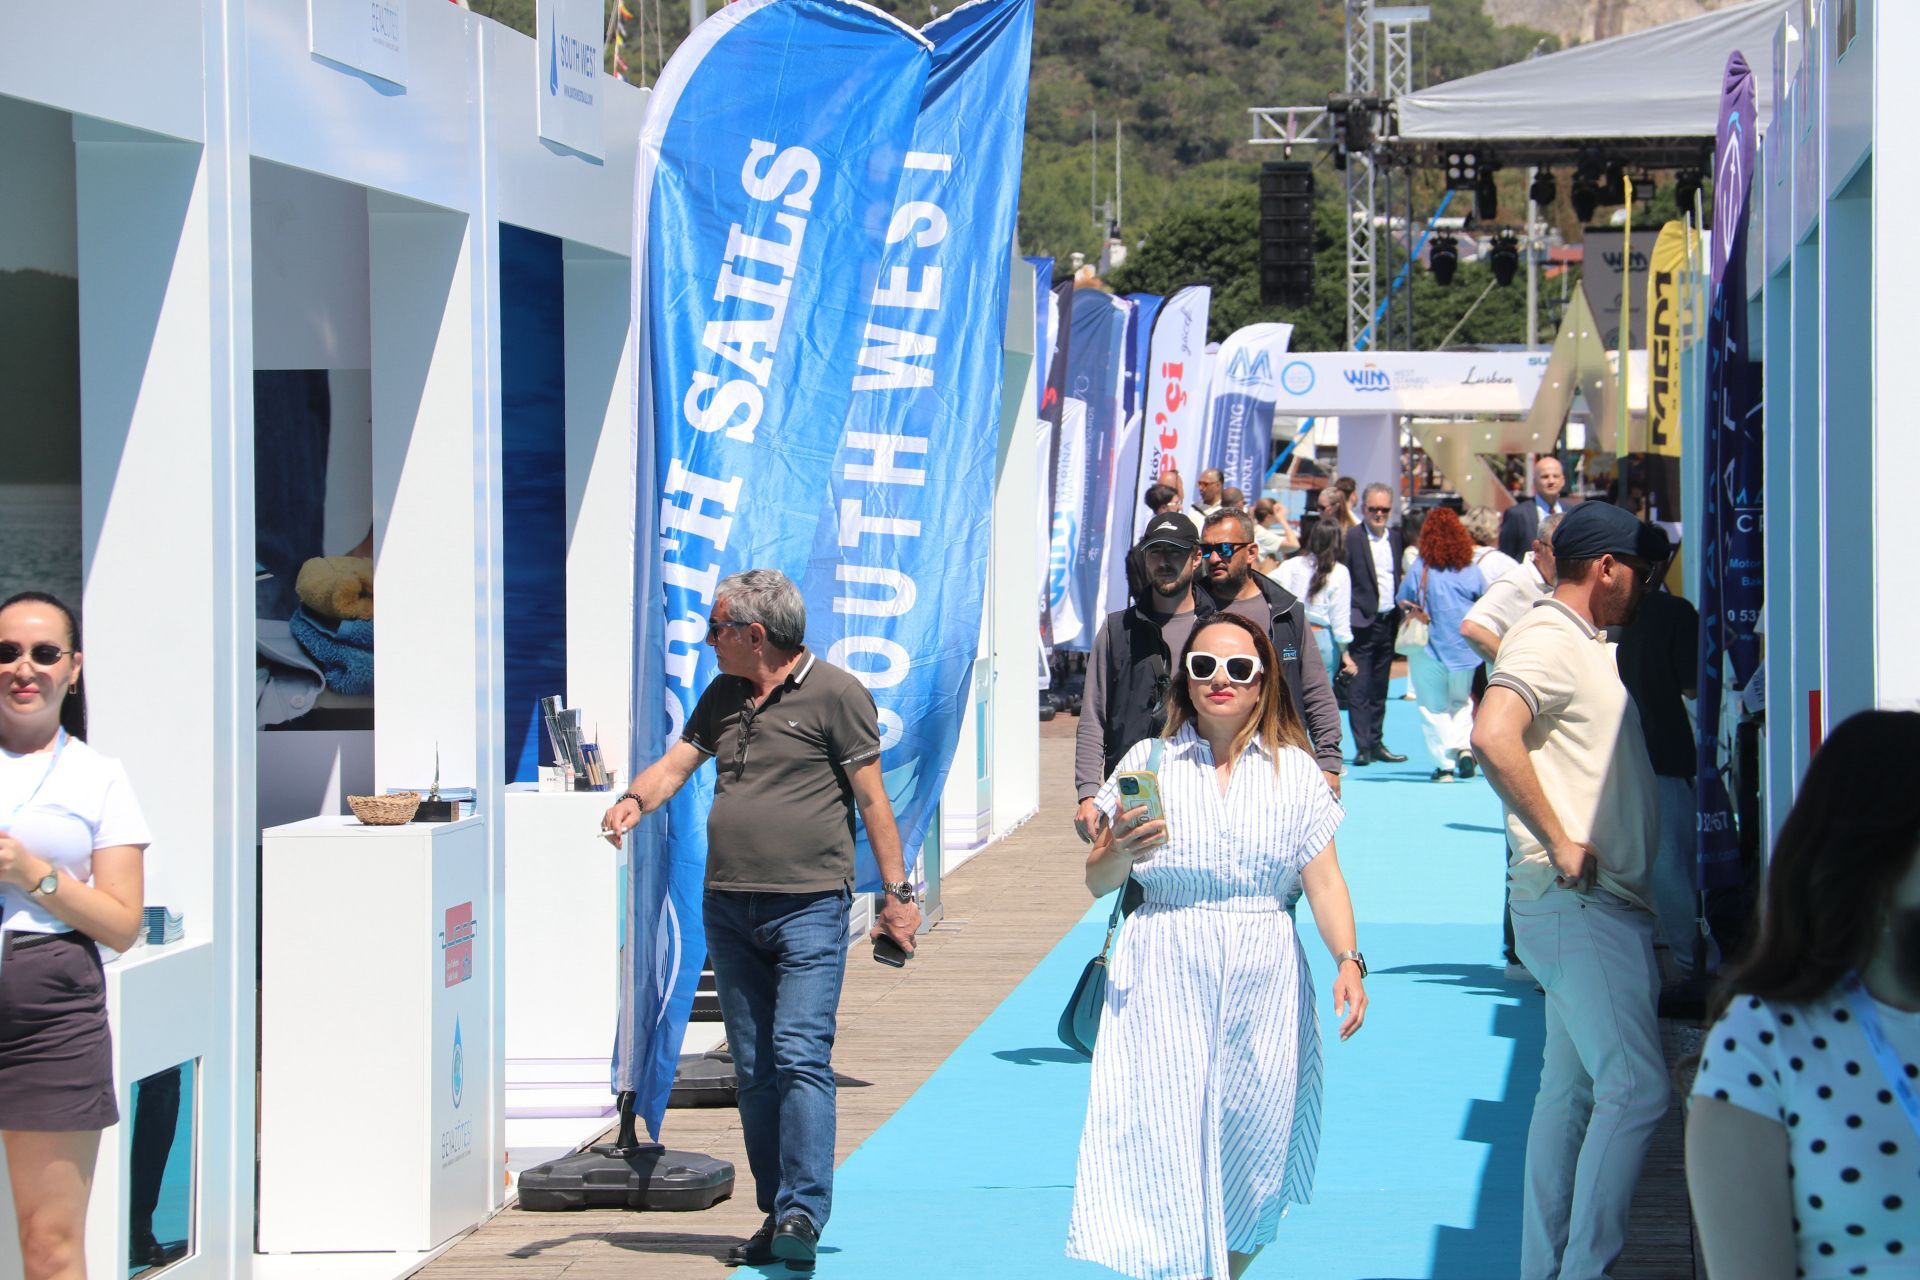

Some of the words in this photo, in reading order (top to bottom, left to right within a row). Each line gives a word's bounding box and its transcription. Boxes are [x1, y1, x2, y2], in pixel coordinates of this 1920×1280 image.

[560, 33, 580, 73] SOUTH
[580, 42, 596, 79] WEST
[683, 137, 821, 443] SAILS
[1149, 446, 1162, 482] köy
[1224, 403, 1245, 483] YACHTING
[659, 457, 743, 751] RTH
